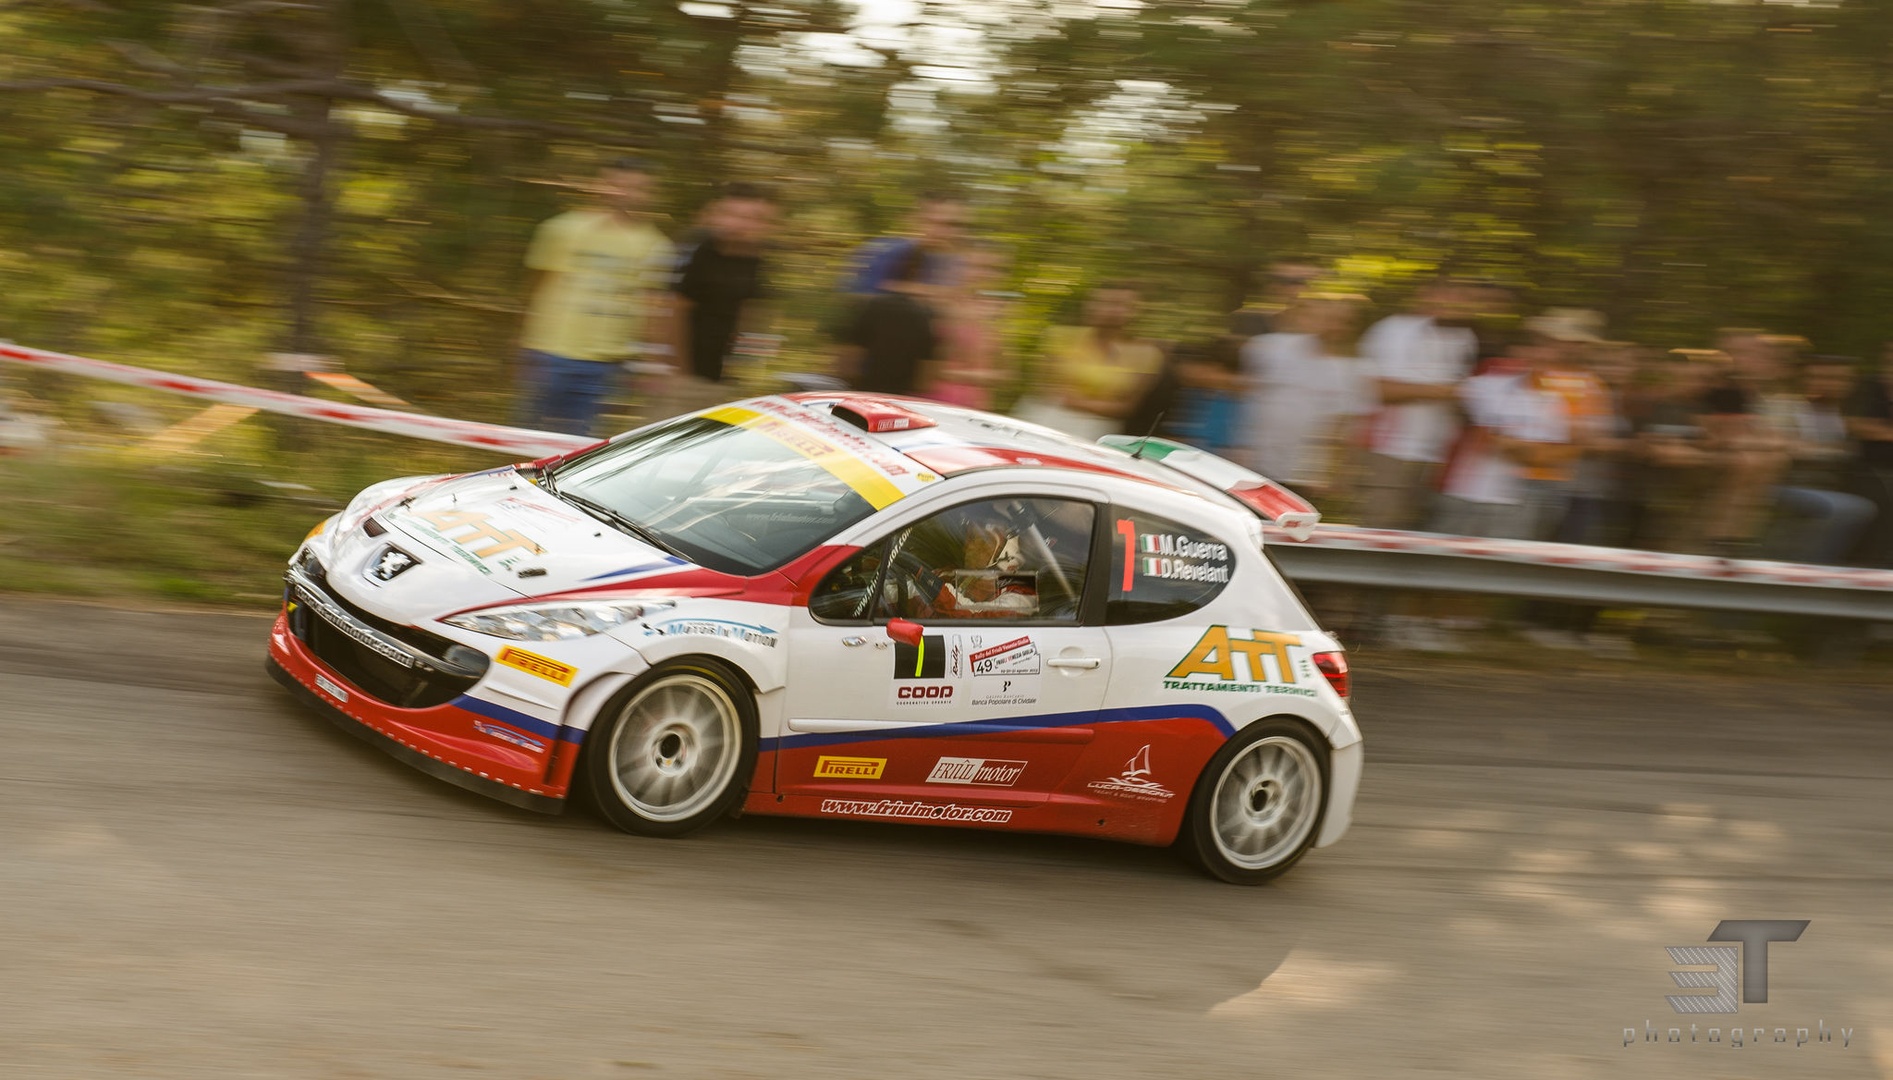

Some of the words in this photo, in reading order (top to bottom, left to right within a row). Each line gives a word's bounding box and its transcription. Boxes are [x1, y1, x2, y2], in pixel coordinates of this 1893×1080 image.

[1116, 518, 1136, 592] 1
[1160, 533, 1228, 561] M.Guerra
[1161, 557, 1229, 584] D.Revelant
[1163, 680, 1262, 694] TRATTAMENTI
[820, 759, 880, 776] PIRELLI
[821, 798, 1013, 823] www.friulmotor.com
